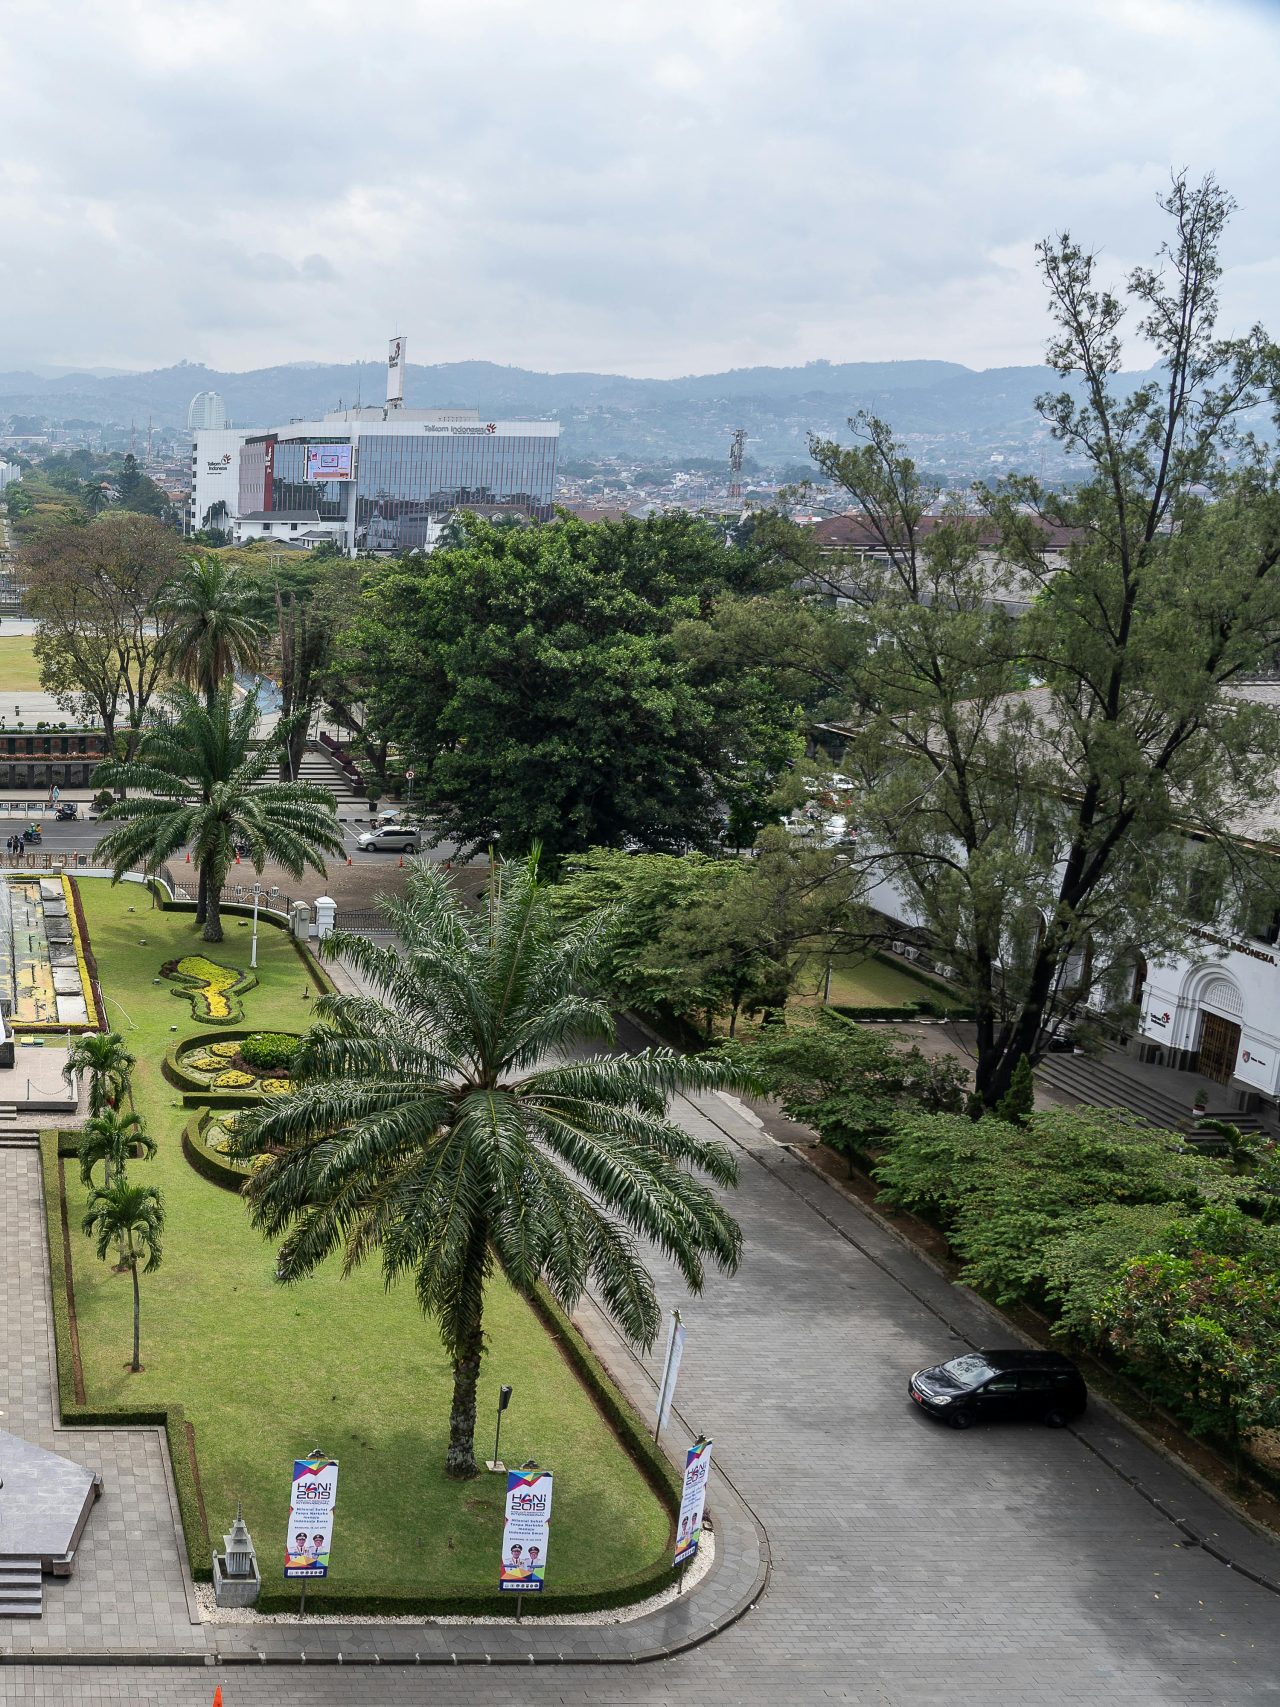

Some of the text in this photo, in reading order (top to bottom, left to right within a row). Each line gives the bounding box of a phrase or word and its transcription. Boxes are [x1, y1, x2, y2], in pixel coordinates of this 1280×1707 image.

[297, 1483, 332, 1492] HANI
[297, 1491, 331, 1499] 2019
[512, 1493, 547, 1503] HANI
[512, 1502, 546, 1511] 2019
